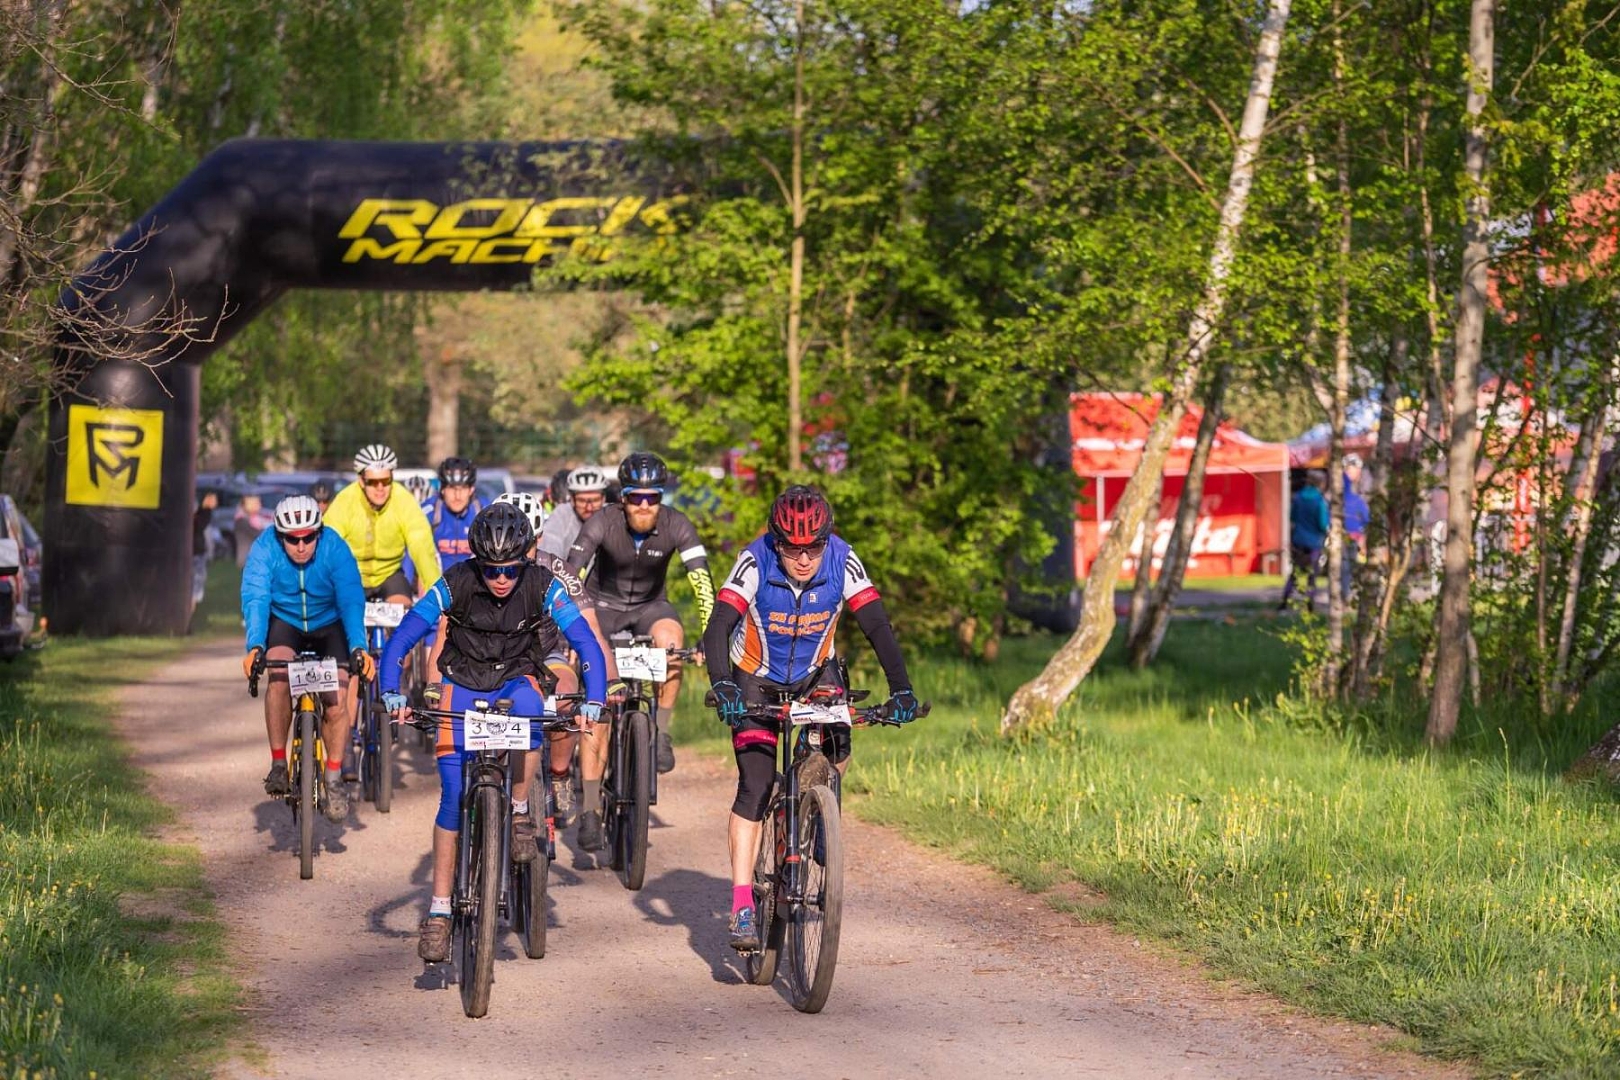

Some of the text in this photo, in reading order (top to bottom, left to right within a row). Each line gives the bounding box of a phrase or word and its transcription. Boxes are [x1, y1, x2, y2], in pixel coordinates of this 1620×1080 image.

[338, 196, 690, 239] ROCK
[323, 670, 333, 682] 6
[471, 722, 522, 735] 3 4
